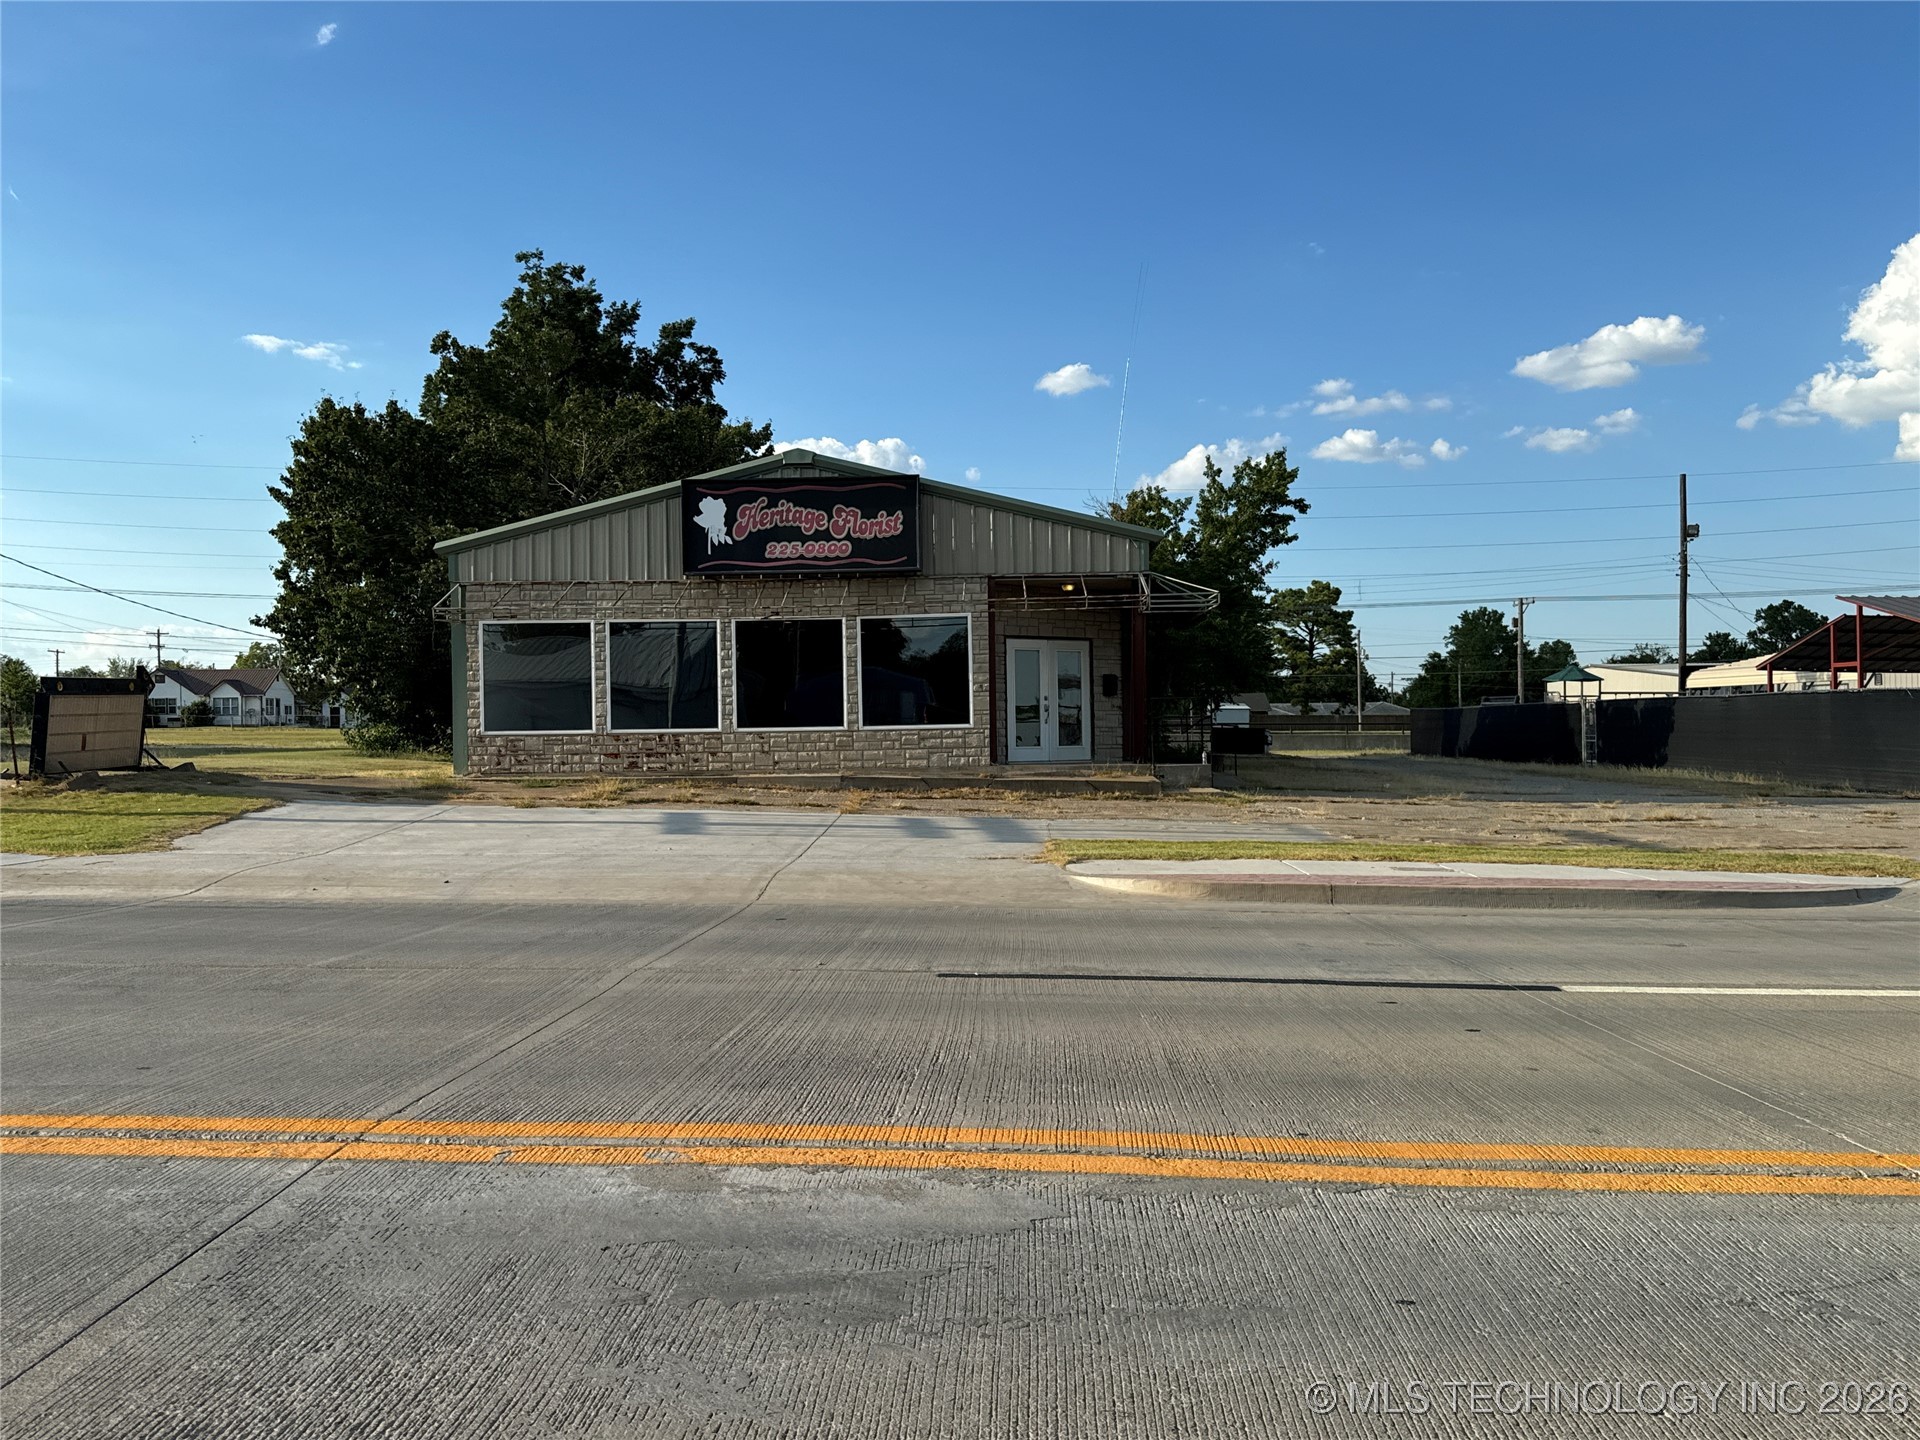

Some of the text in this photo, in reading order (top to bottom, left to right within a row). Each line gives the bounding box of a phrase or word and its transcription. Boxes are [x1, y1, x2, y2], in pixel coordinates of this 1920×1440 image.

[732, 496, 903, 541] Heritage Florist
[765, 540, 852, 558] 225-0800
